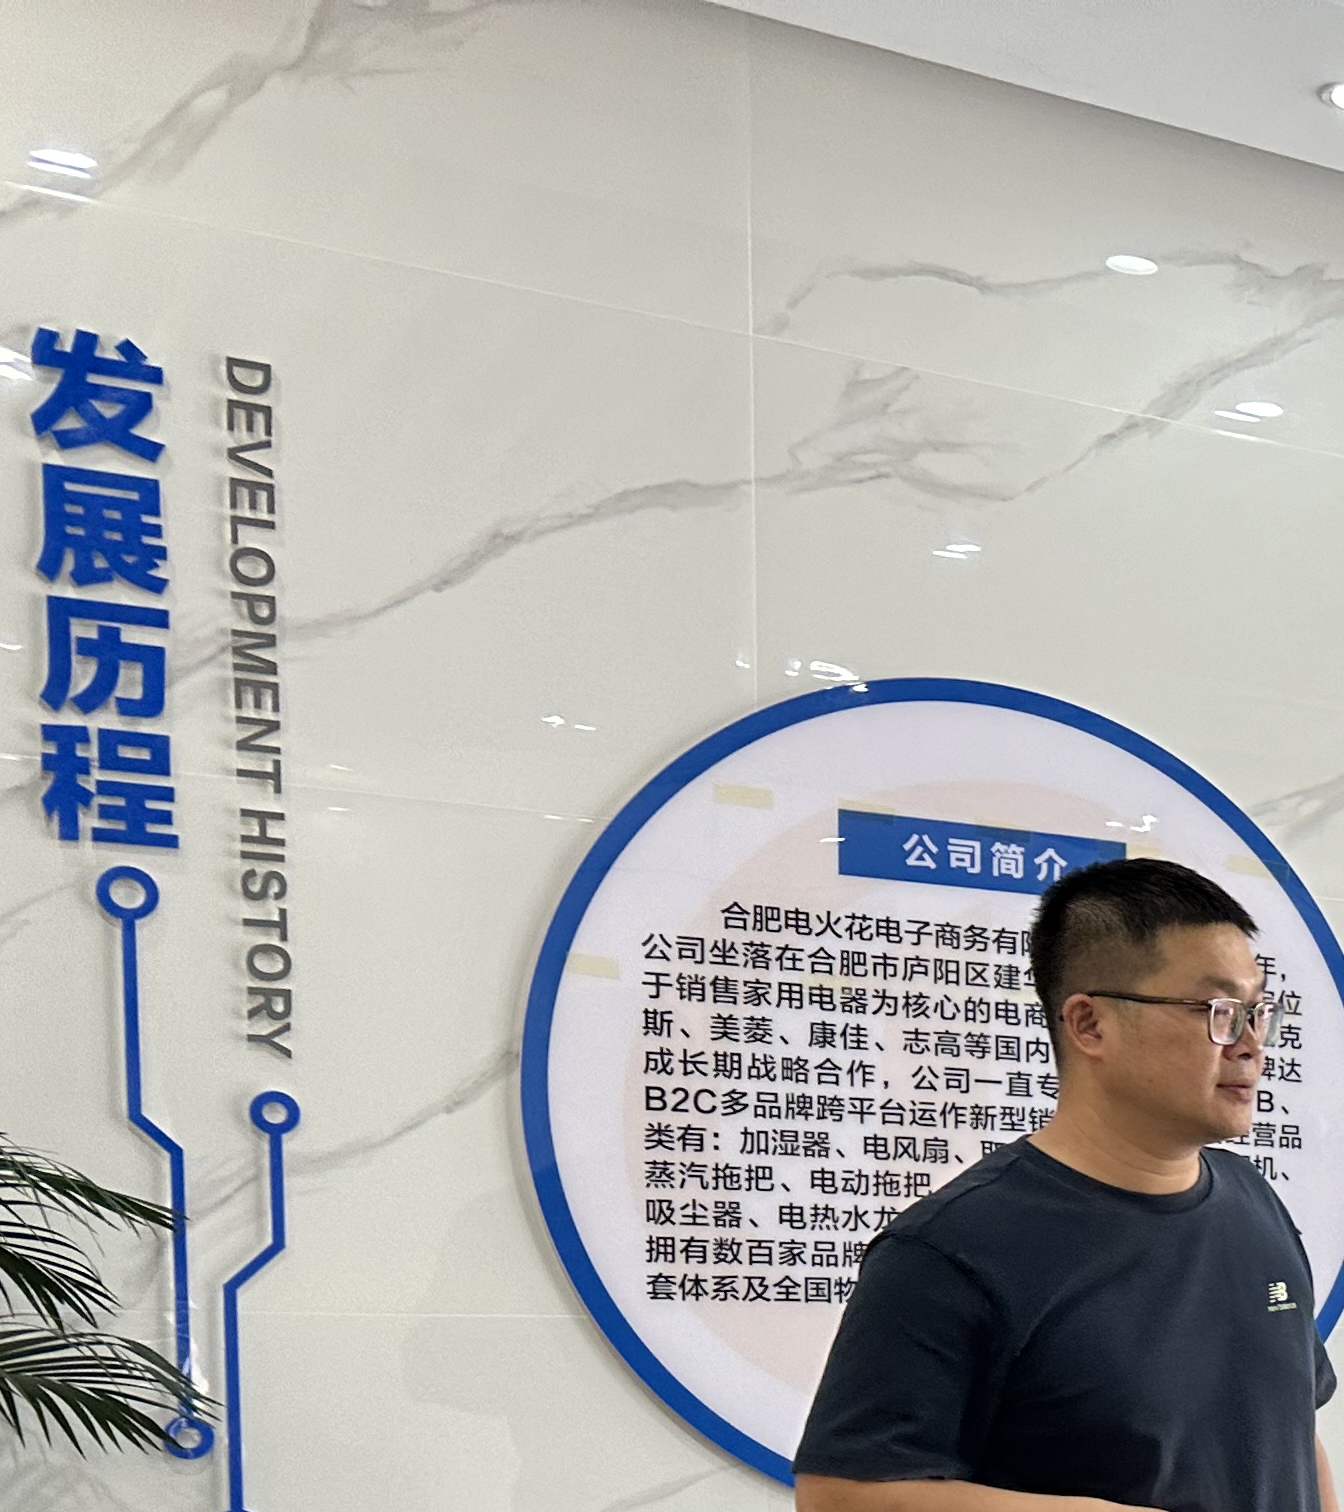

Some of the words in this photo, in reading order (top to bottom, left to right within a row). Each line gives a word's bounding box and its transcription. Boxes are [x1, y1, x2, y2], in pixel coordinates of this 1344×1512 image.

[29, 326, 180, 850] 发展历程
[223, 355, 283, 794] DEVELOPMENT
[902, 832, 1068, 882] 公司简介
[238, 806, 294, 1060] HISTORY
[642, 1007, 1050, 1064] 斯、美菱、康佳、志高等国内
[645, 1236, 868, 1267] 拥有数百家品牌
[646, 1273, 858, 1304] 套体系及全国物
